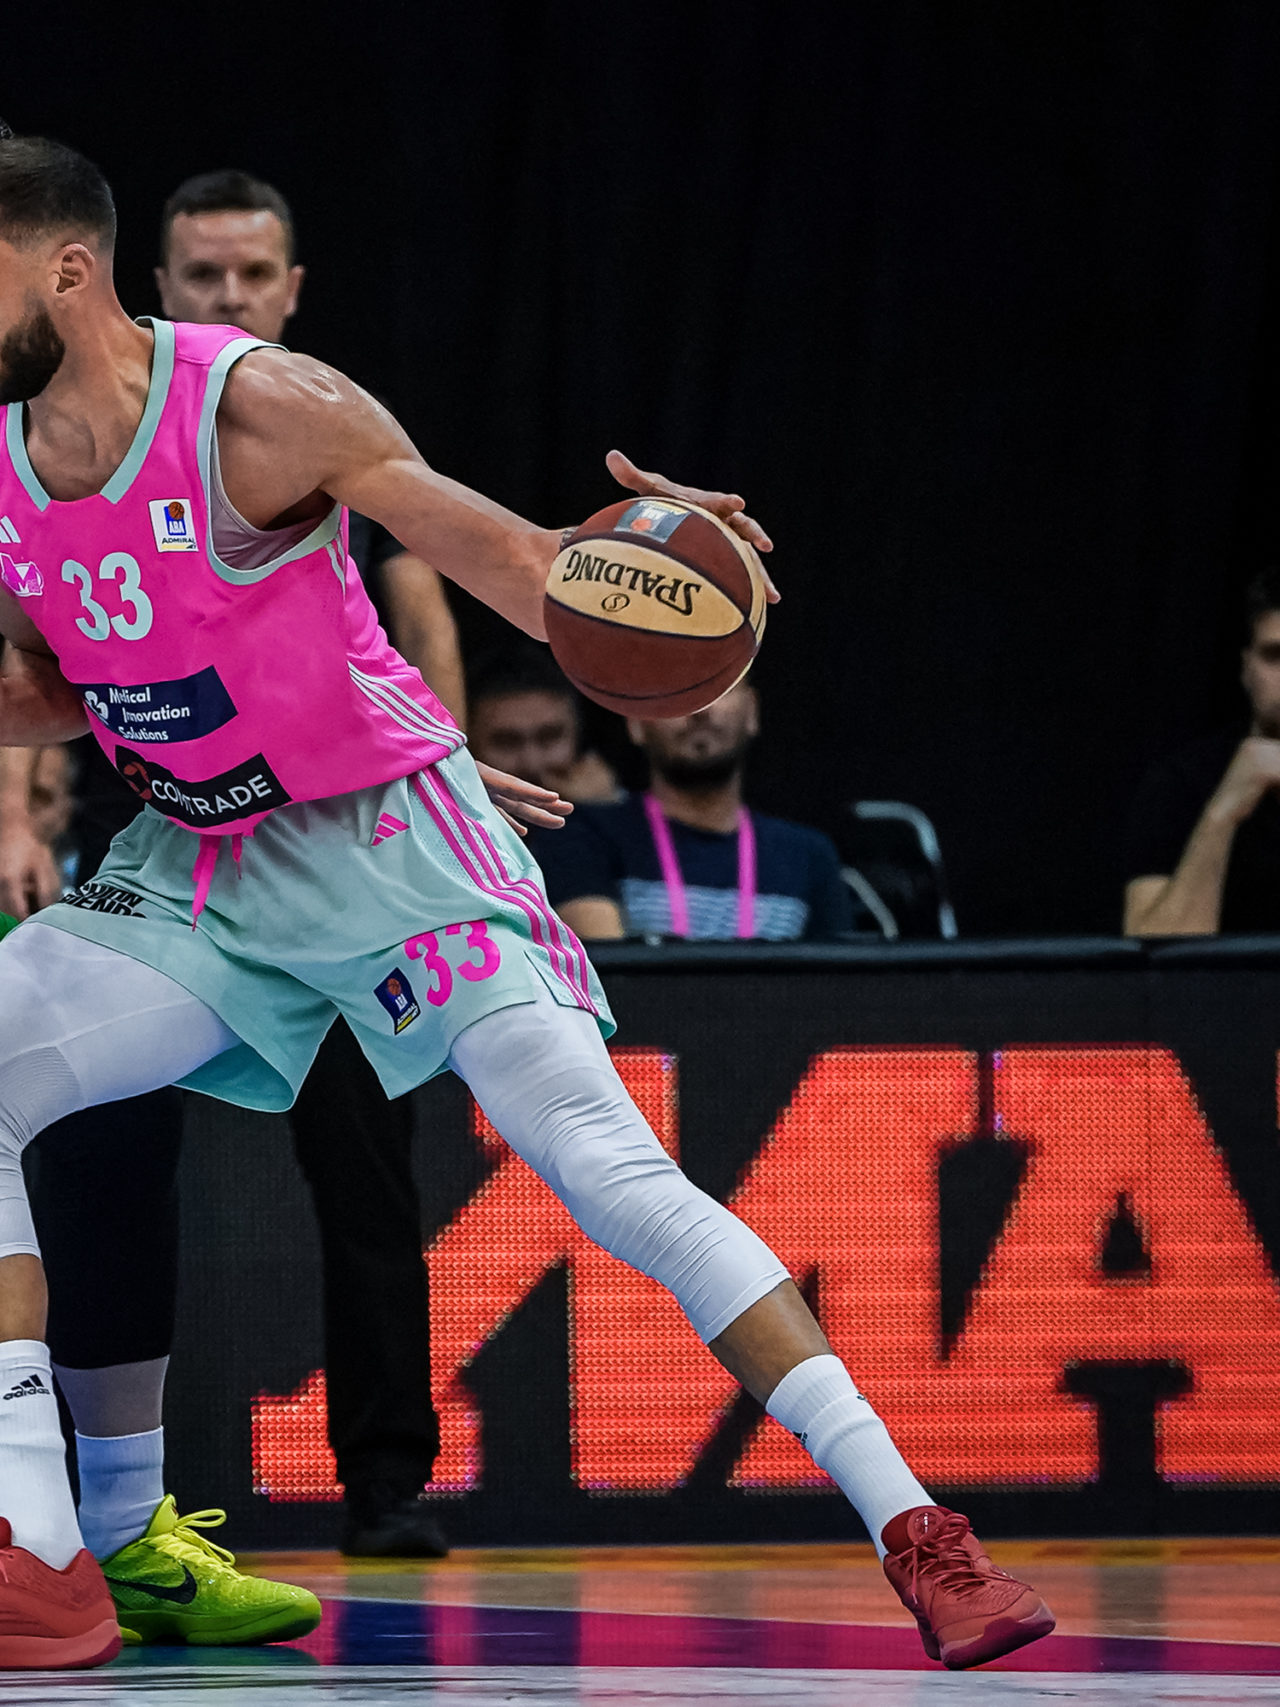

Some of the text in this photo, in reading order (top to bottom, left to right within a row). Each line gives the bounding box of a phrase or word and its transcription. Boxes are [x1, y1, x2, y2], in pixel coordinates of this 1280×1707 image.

[61, 552, 153, 641] 33
[563, 550, 701, 615] SPALDING
[404, 919, 501, 1007] 33
